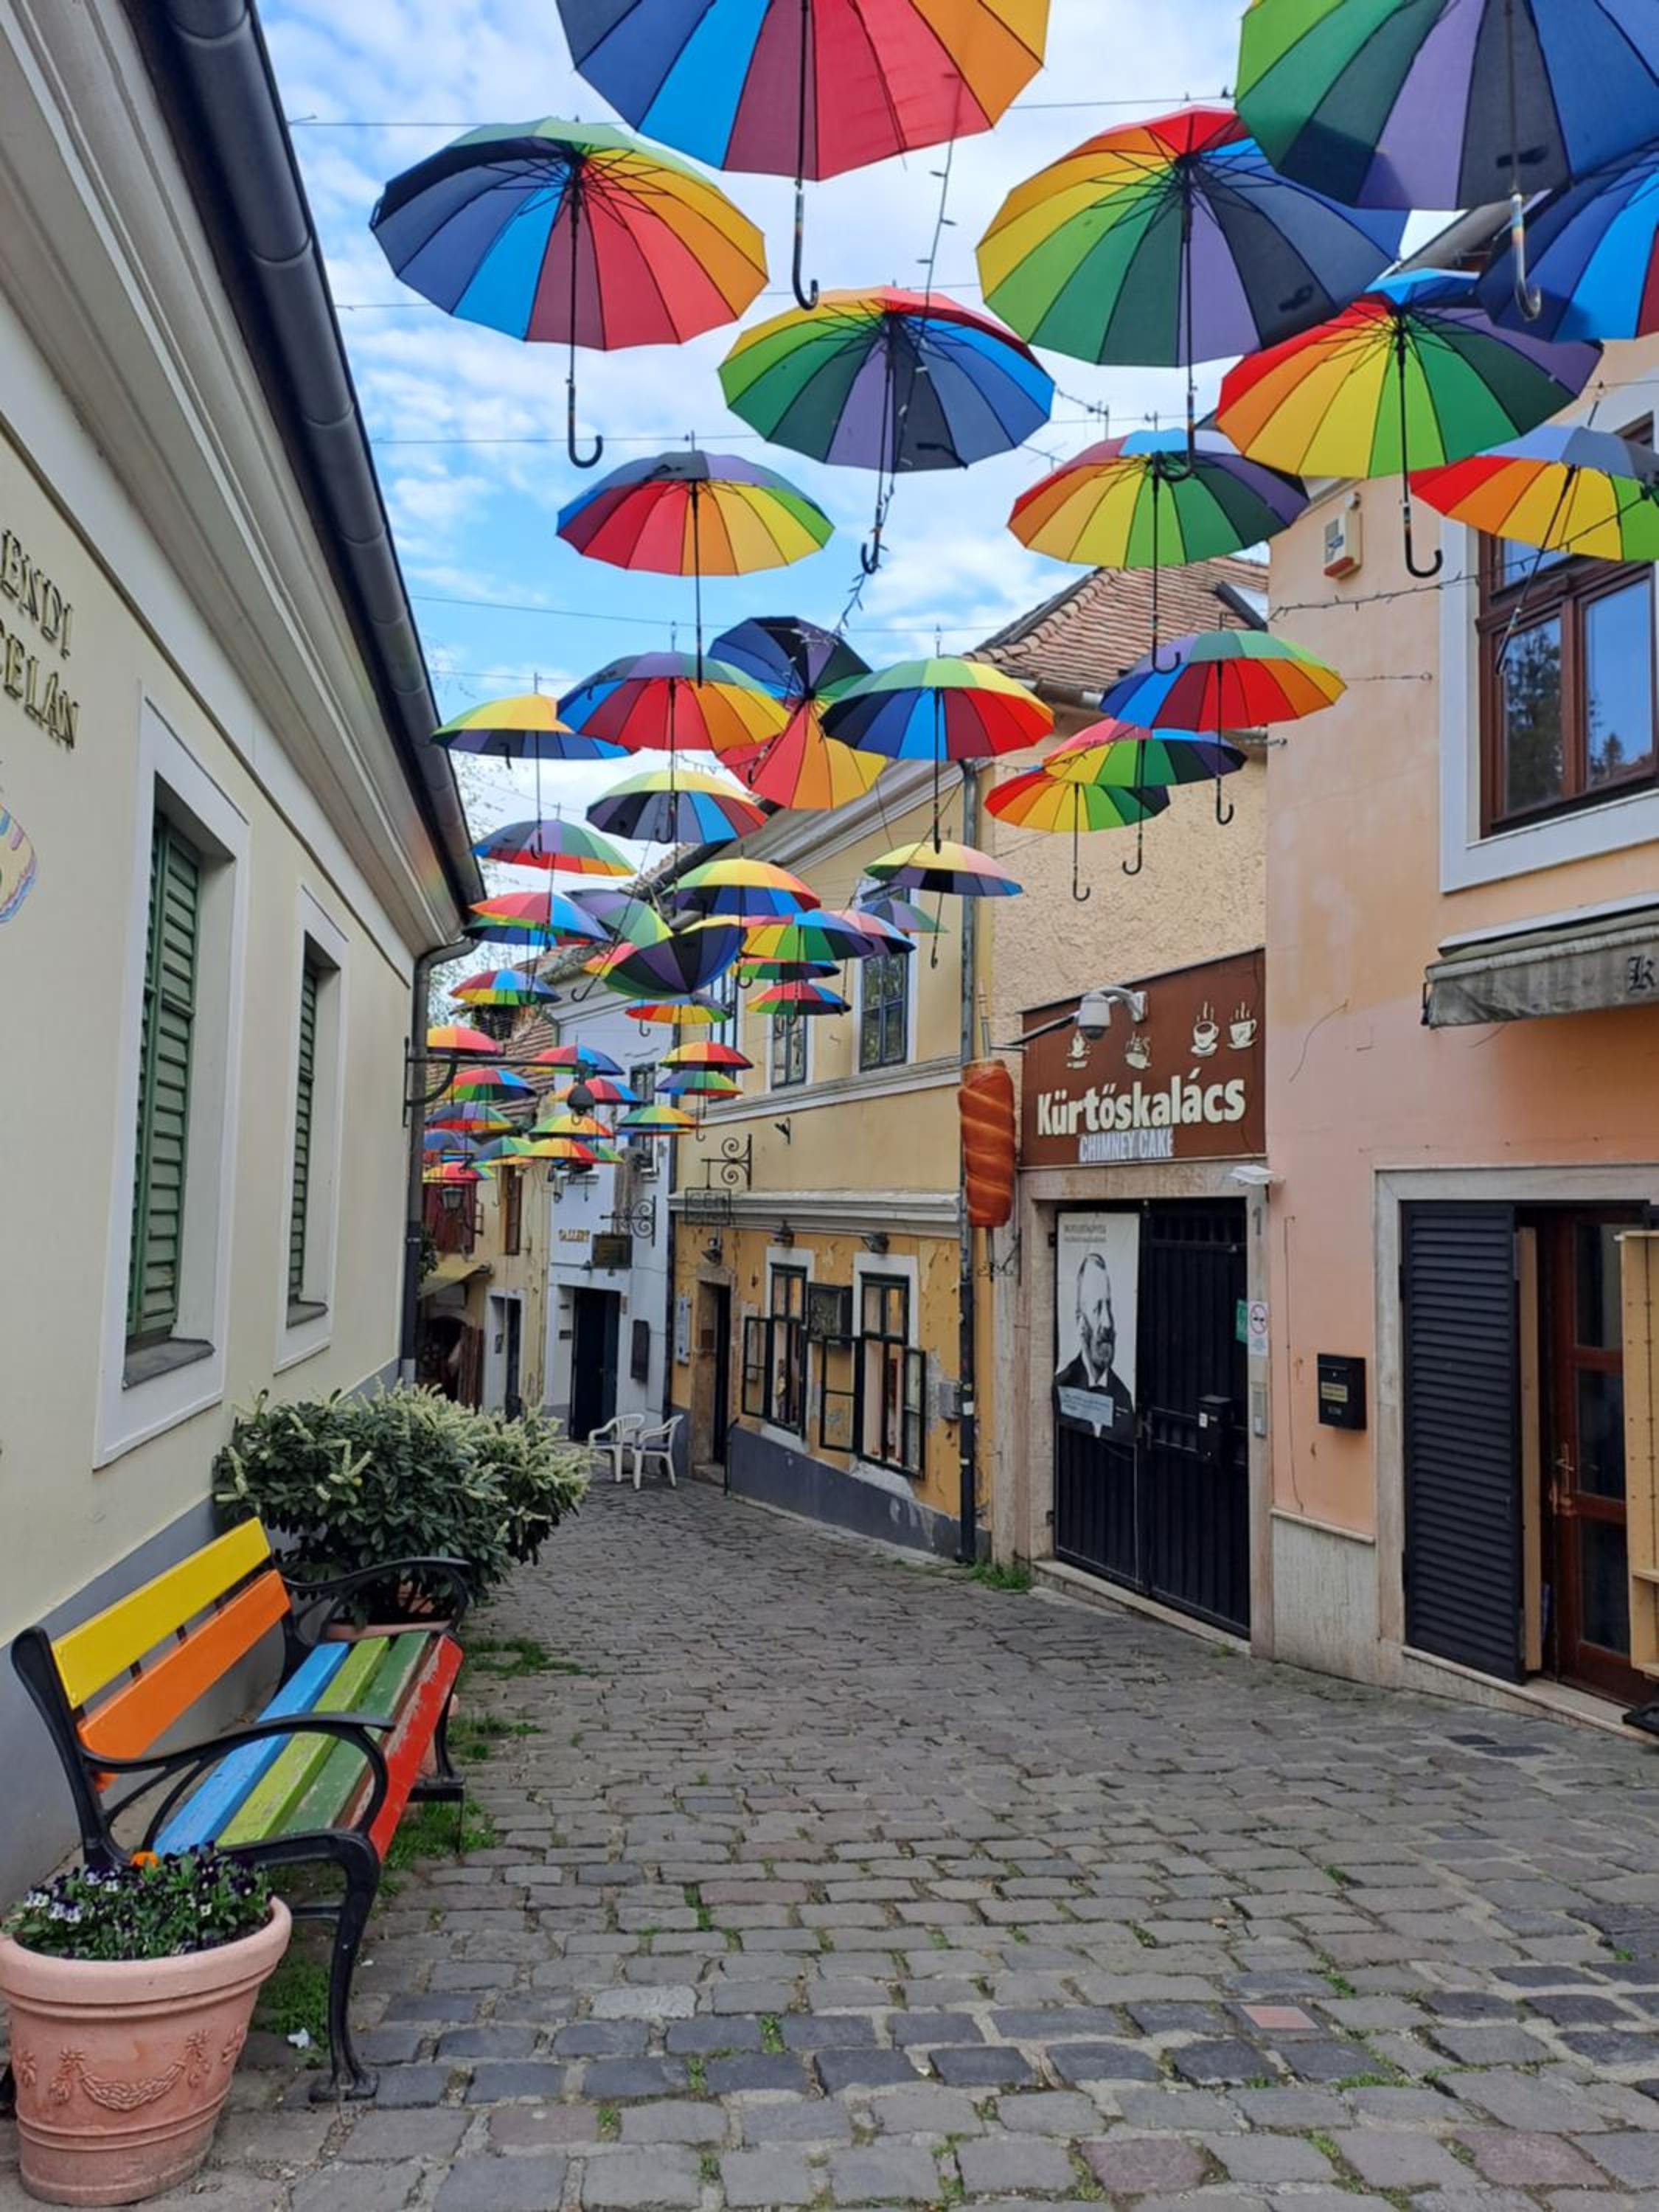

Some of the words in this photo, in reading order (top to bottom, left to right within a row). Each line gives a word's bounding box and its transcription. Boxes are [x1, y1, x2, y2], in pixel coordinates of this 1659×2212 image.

[1037, 1067, 1246, 1135] Kürtőskalács
[1079, 1130, 1135, 1162] CHIMNEY
[1138, 1127, 1174, 1158] CAKE
